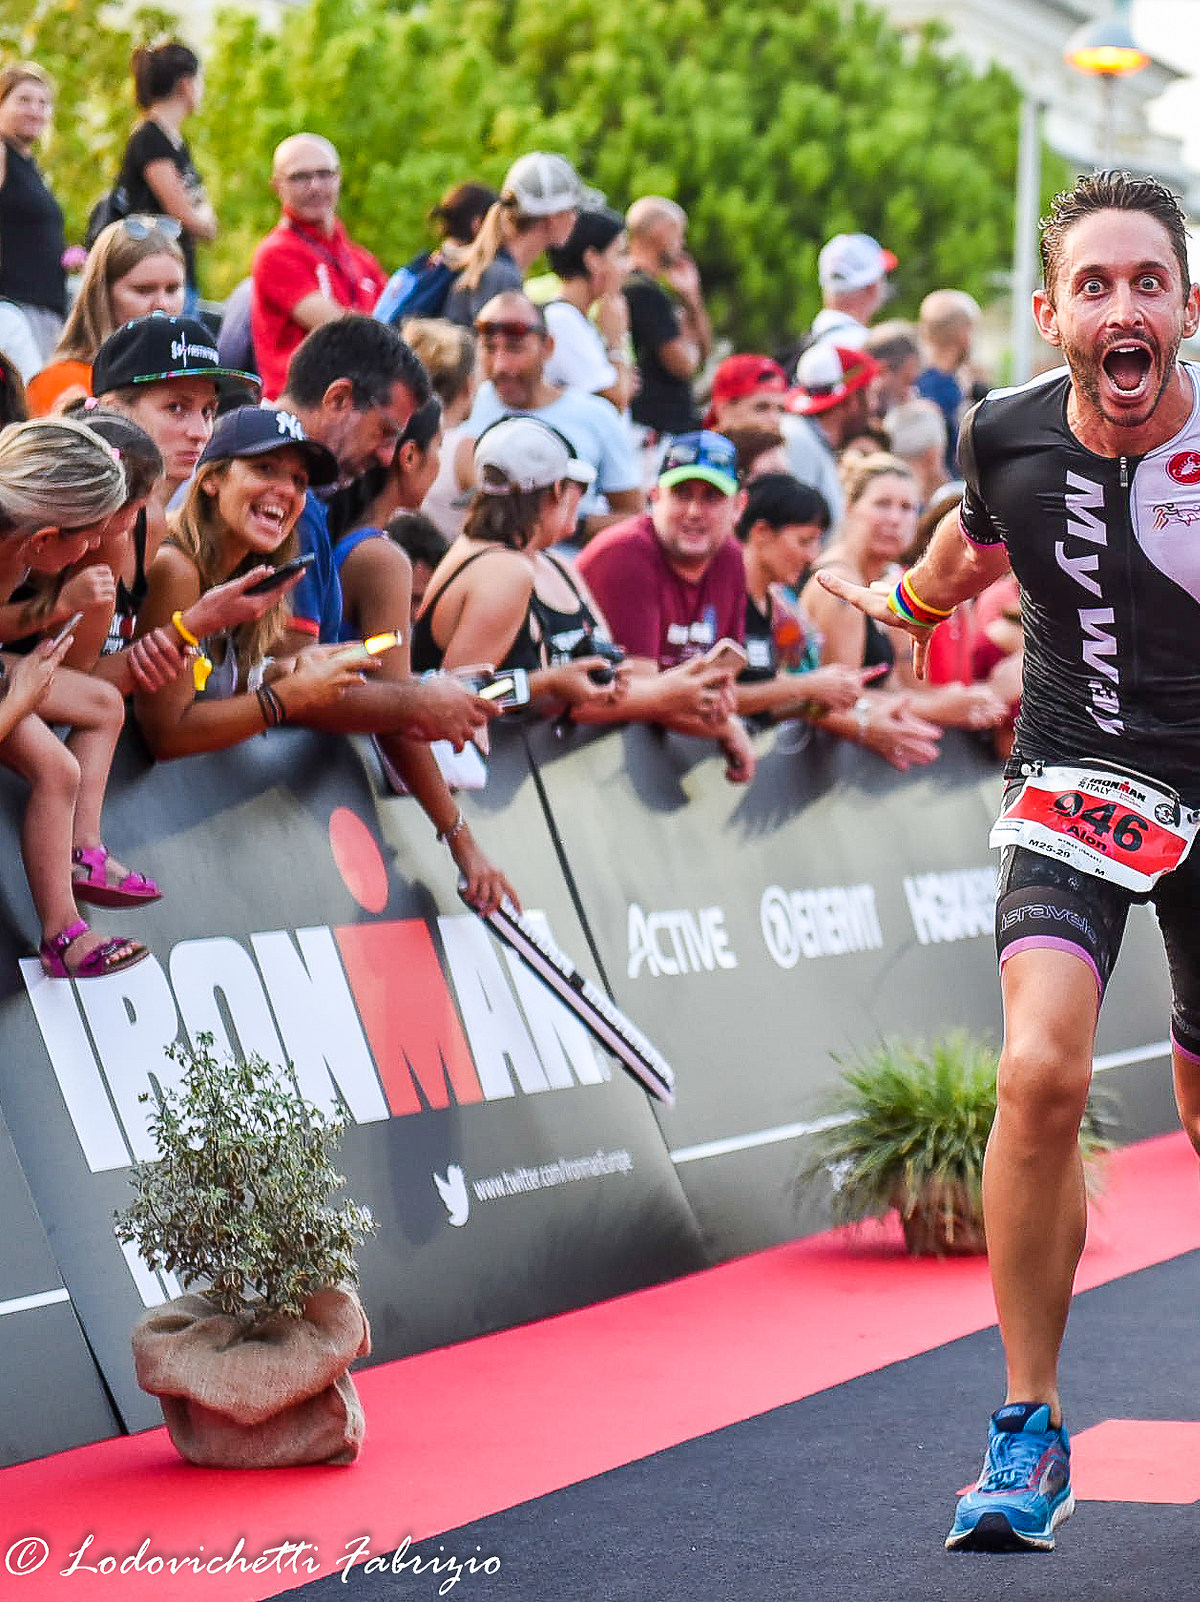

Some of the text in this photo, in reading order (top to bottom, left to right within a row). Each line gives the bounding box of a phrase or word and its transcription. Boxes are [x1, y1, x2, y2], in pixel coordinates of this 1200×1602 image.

[1086, 783, 1112, 795] ITALY
[1089, 778, 1147, 802] IRONMAN
[1049, 792, 1149, 852] 946
[1028, 838, 1071, 859] M25-29
[1066, 825, 1108, 852] Alon
[627, 902, 738, 979] ACTIVE
